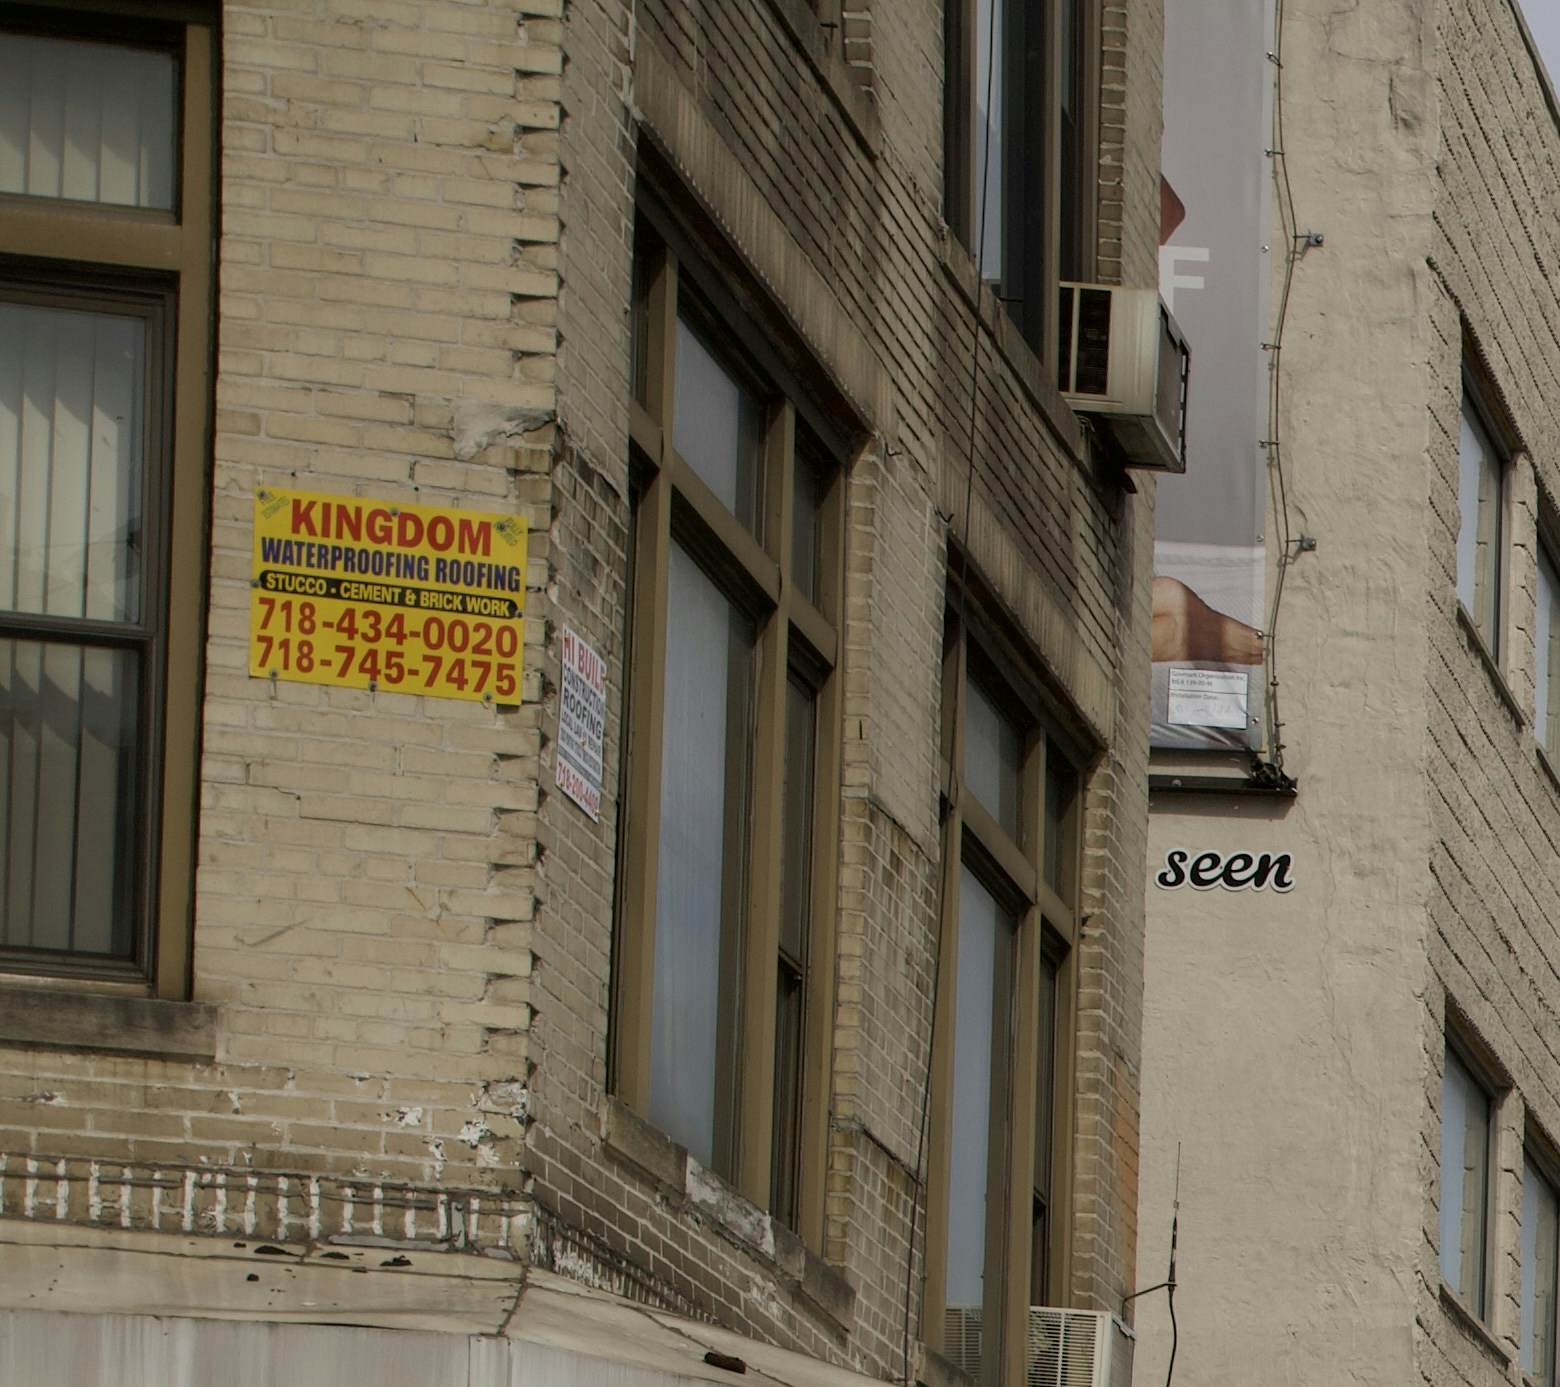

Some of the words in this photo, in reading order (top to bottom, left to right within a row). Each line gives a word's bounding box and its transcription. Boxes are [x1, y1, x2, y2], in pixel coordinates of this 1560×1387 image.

[291, 499, 492, 557] KINGDOM
[261, 536, 429, 583] WATERPROOFING
[434, 557, 521, 593] ROOFING
[266, 572, 328, 597] STUCCO
[340, 581, 402, 605] CEMENT
[404, 590, 417, 606] &
[420, 592, 462, 612] BRICK
[465, 596, 511, 618] WORK
[258, 597, 519, 659] 718-434-0020
[256, 635, 517, 697] 718-745-7475
[562, 687, 602, 741] ROOFING
[1158, 848, 1294, 891] seen
